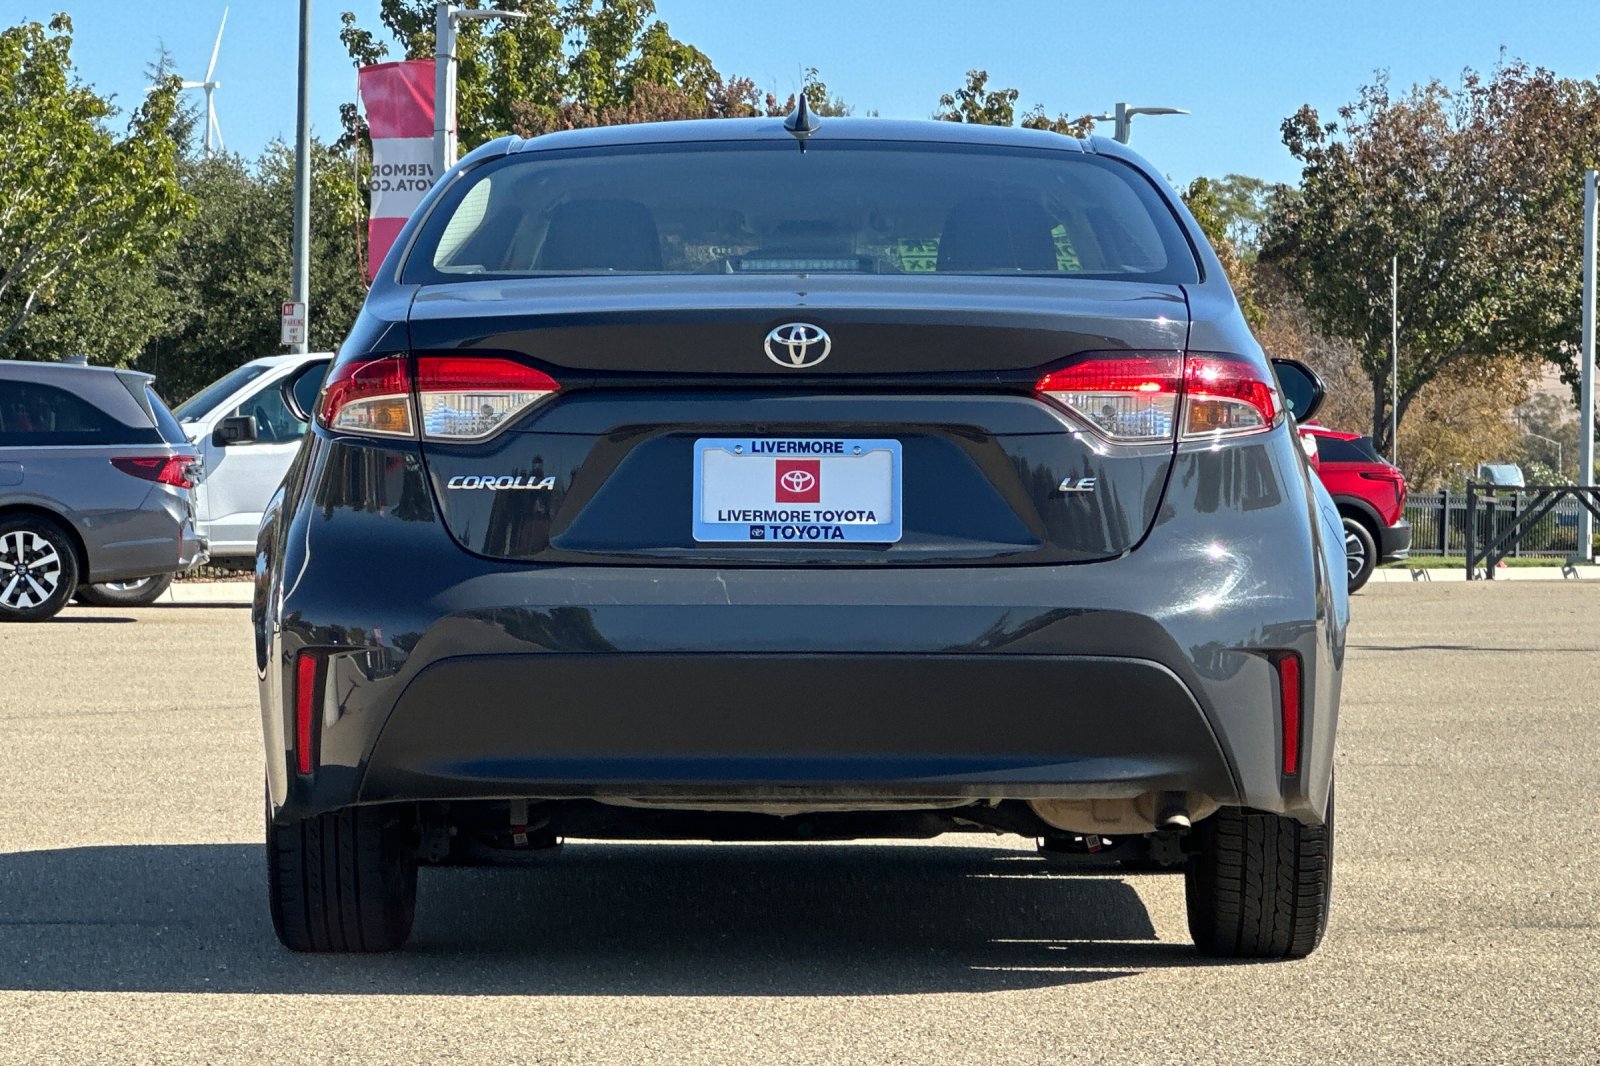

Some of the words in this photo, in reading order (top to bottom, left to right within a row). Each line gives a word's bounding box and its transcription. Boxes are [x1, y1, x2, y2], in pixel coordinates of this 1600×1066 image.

[751, 441, 844, 454] LIVERMORE
[447, 475, 556, 491] COROLLA
[1058, 477, 1097, 492] LE
[718, 509, 811, 522] LIVERMORE
[813, 510, 876, 522] TOYOTA
[770, 525, 845, 540] TOYOTA
